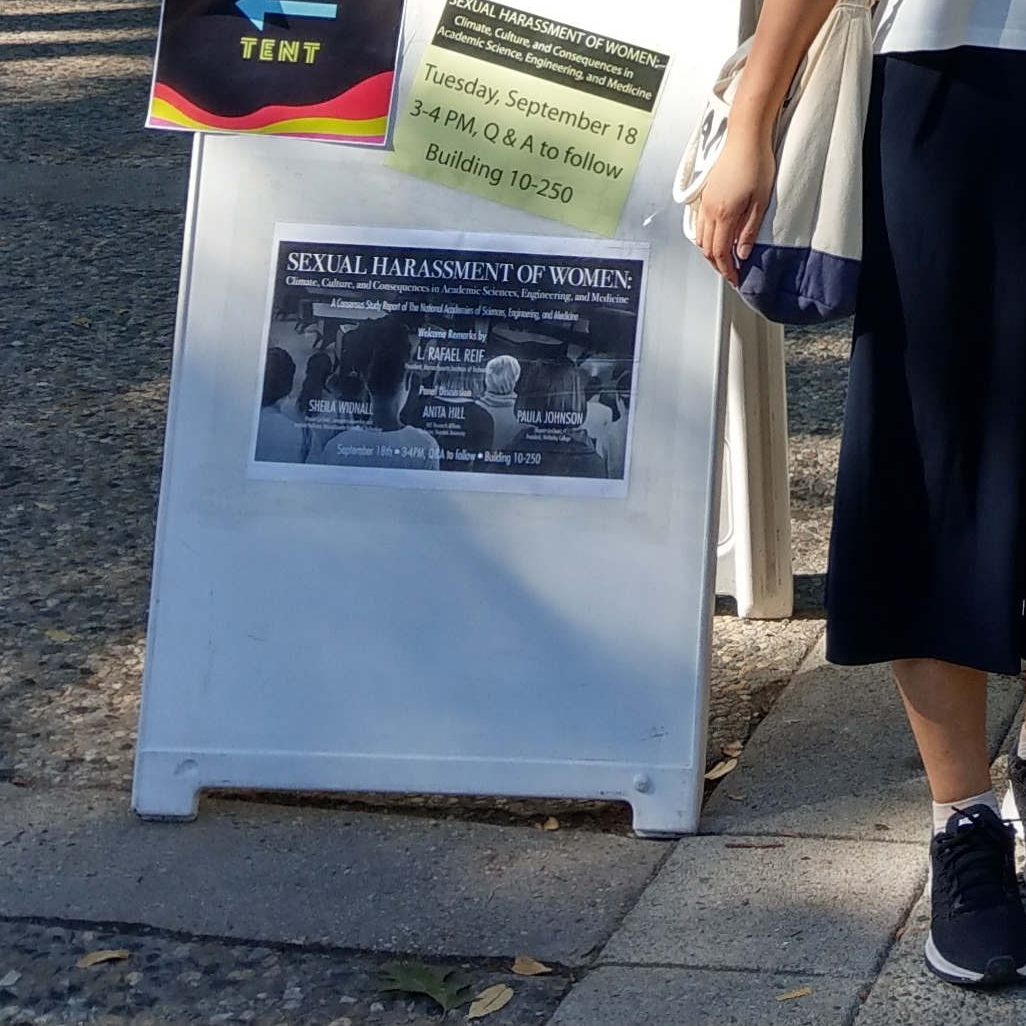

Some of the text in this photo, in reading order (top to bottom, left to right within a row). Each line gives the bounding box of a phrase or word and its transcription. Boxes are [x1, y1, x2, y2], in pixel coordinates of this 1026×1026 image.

[499, 8, 585, 44] HARASSMENT
[585, 35, 604, 50] OF
[240, 37, 320, 64] TENT
[454, 15, 634, 78] Climate, Culture, and Consequences in
[437, 26, 652, 100] Academic Science, Engineering, and Medicine
[424, 64, 638, 145] Tuesday, September 18
[410, 100, 623, 179] 3-4 PM, Q & A to follow
[426, 143, 573, 204] Building 10-250
[287, 252, 632, 289] SEXUAL HARASSMENT OF WOMEN:
[286, 276, 629, 303] Climate, Culture, and Consequences in Academic Sciences, Engineering, and Medicine
[331, 298, 336, 307] A
[337, 298, 364, 309] Consensus
[366, 298, 381, 311] Study
[383, 300, 400, 311] Report
[401, 301, 408, 310] of
[409, 302, 418, 311] The
[421, 303, 443, 312] National
[444, 304, 473, 315] Academies
[475, 305, 481, 315] of
[542, 311, 552, 320] and
[554, 312, 578, 321] Medicine
[418, 327, 487, 343] Welcome Remarks by
[428, 347, 460, 361] RAFAEL
[464, 348, 485, 362] REIF
[419, 385, 472, 396] Panel Discussion
[309, 400, 373, 415] SHEILA WIDNALL
[423, 406, 465, 419] ANITA HILL
[517, 410, 583, 424] PAULA JOHNSON
[337, 444, 373, 457] September
[376, 446, 392, 456] 18th
[428, 448, 444, 459] Q&A
[447, 450, 454, 459] to
[455, 449, 476, 460] follow
[485, 450, 510, 465] Building
[514, 452, 541, 464] 10-250
